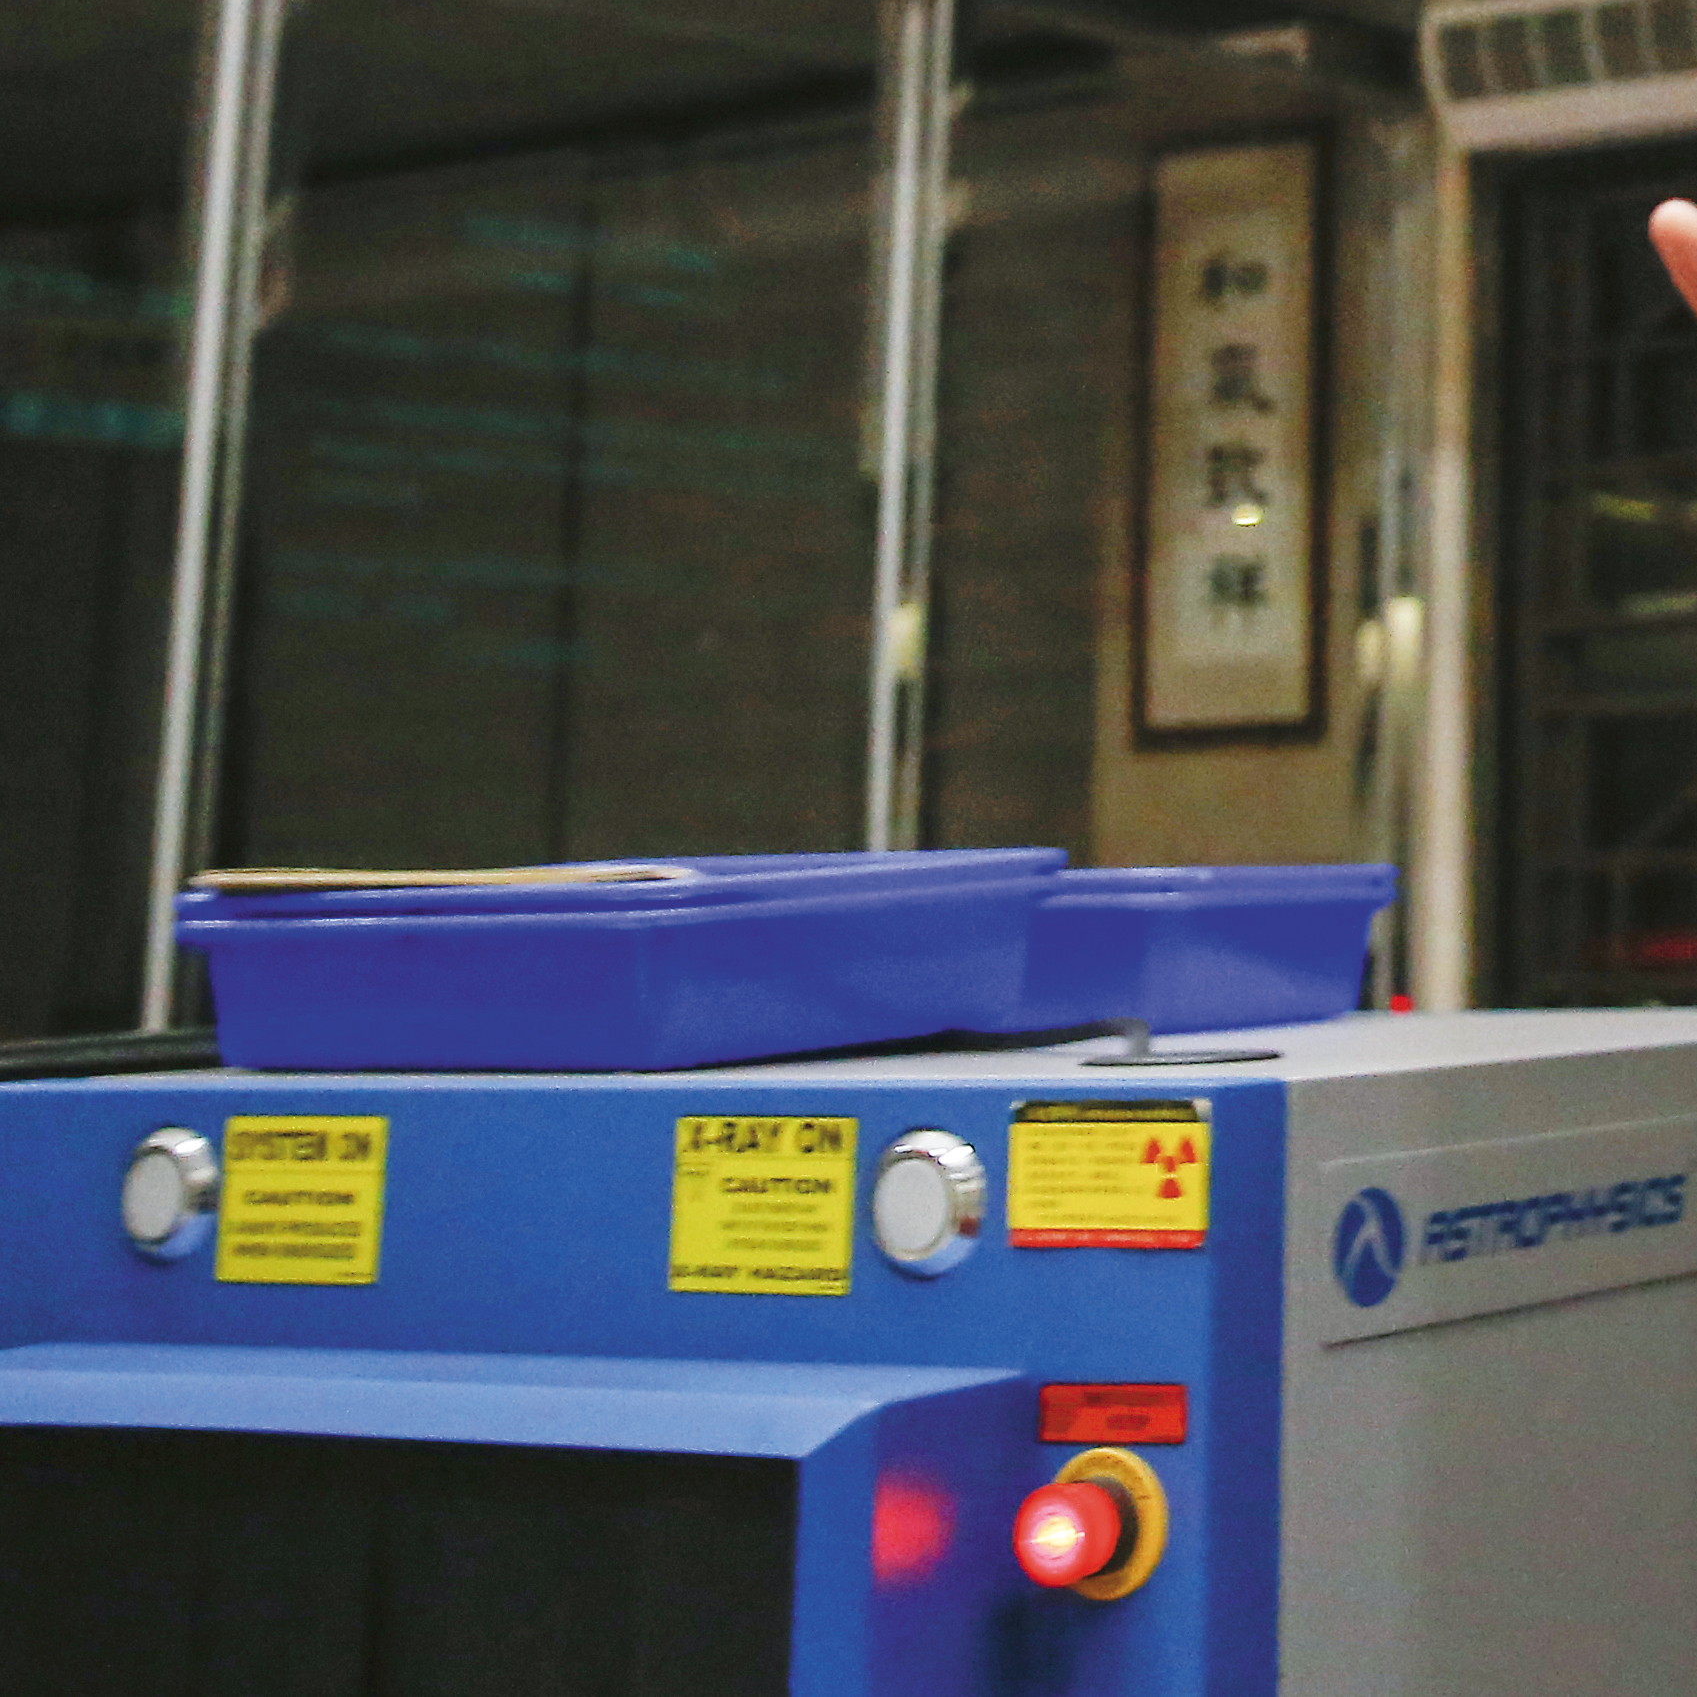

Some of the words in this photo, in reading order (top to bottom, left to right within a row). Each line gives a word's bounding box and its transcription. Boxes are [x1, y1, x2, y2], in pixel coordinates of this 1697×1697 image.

[682, 1119, 784, 1154] X-RAY
[796, 1119, 844, 1154] ON
[720, 1175, 834, 1195] CAUTION
[243, 1188, 356, 1207] CAUTION
